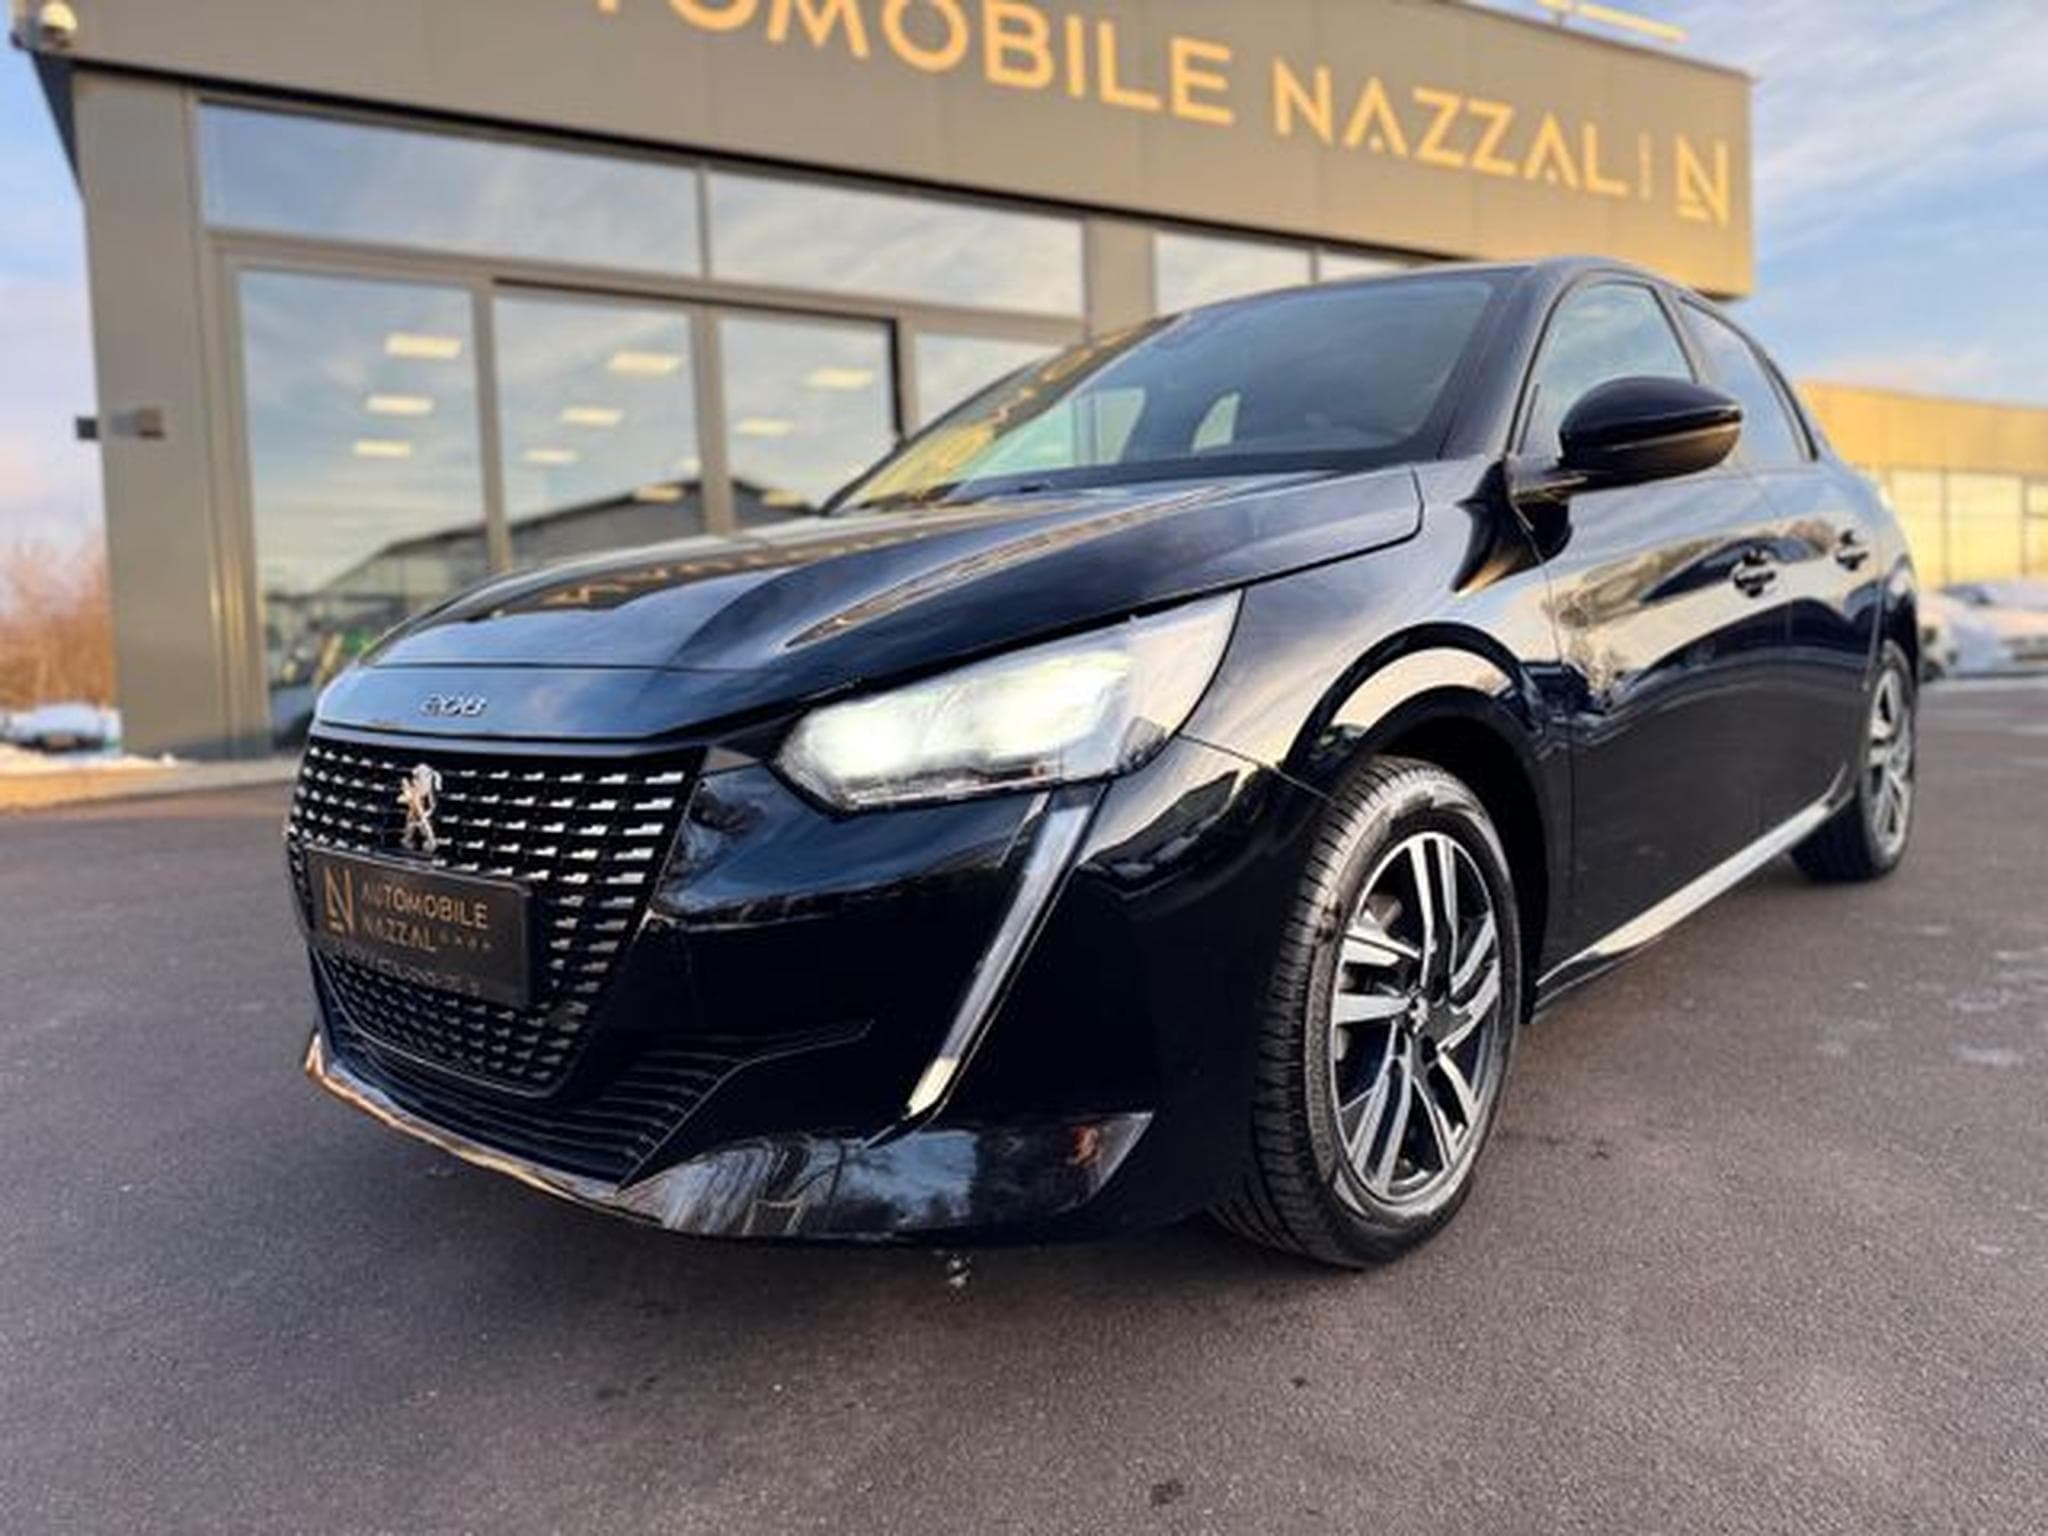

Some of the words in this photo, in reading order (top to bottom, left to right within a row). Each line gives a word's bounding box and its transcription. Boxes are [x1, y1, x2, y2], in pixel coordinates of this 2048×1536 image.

[600, 0, 1233, 126] MOBILE
[1272, 57, 1628, 197] NAZZAL
[361, 881, 489, 930] AUTOMOBILE
